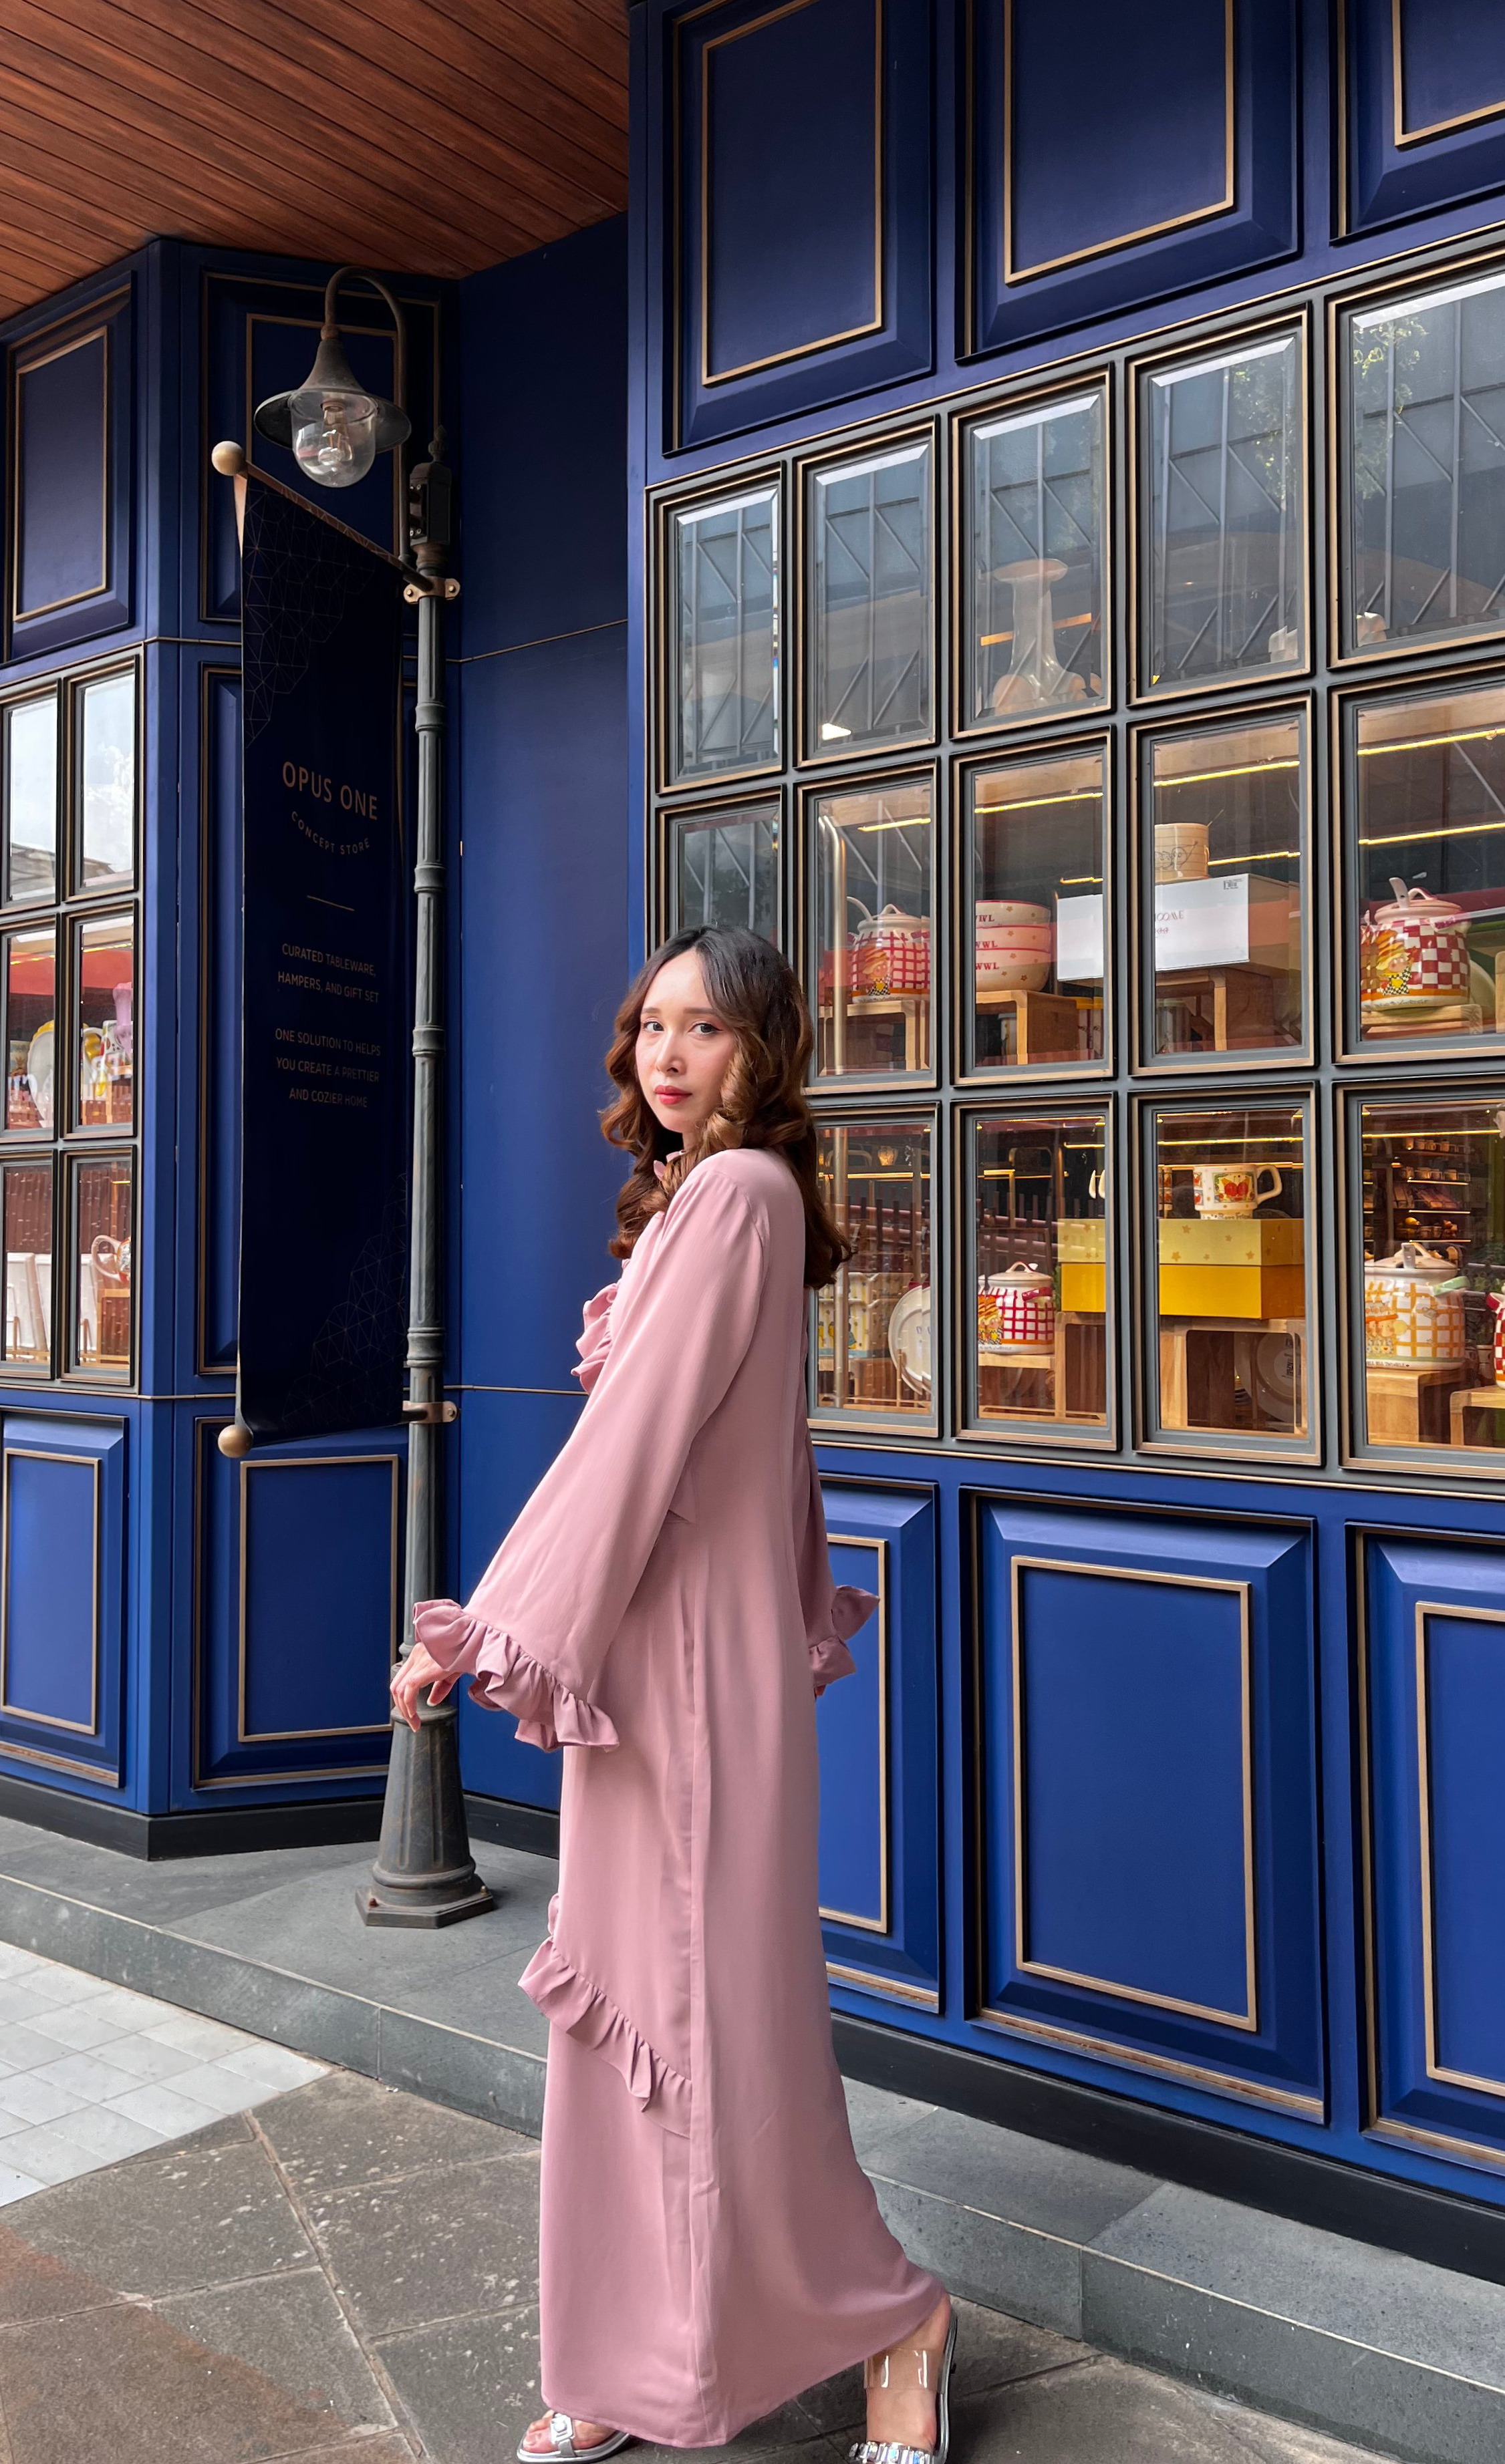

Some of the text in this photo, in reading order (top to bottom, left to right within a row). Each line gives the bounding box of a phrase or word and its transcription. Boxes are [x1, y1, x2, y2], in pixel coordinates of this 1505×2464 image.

[282, 761, 378, 821] OPUS ONE
[291, 810, 371, 855] CONCEPT STORE
[281, 943, 377, 977] CURATED TABLEWARE,
[277, 971, 380, 1004] HAMPERS, AND GIFT SET
[275, 1028, 381, 1056] ONE SOLUTION TO HELPS
[276, 1056, 380, 1083] YOU CREATE A PRETTIER
[289, 1087, 368, 1108] AND COZIER HOME
